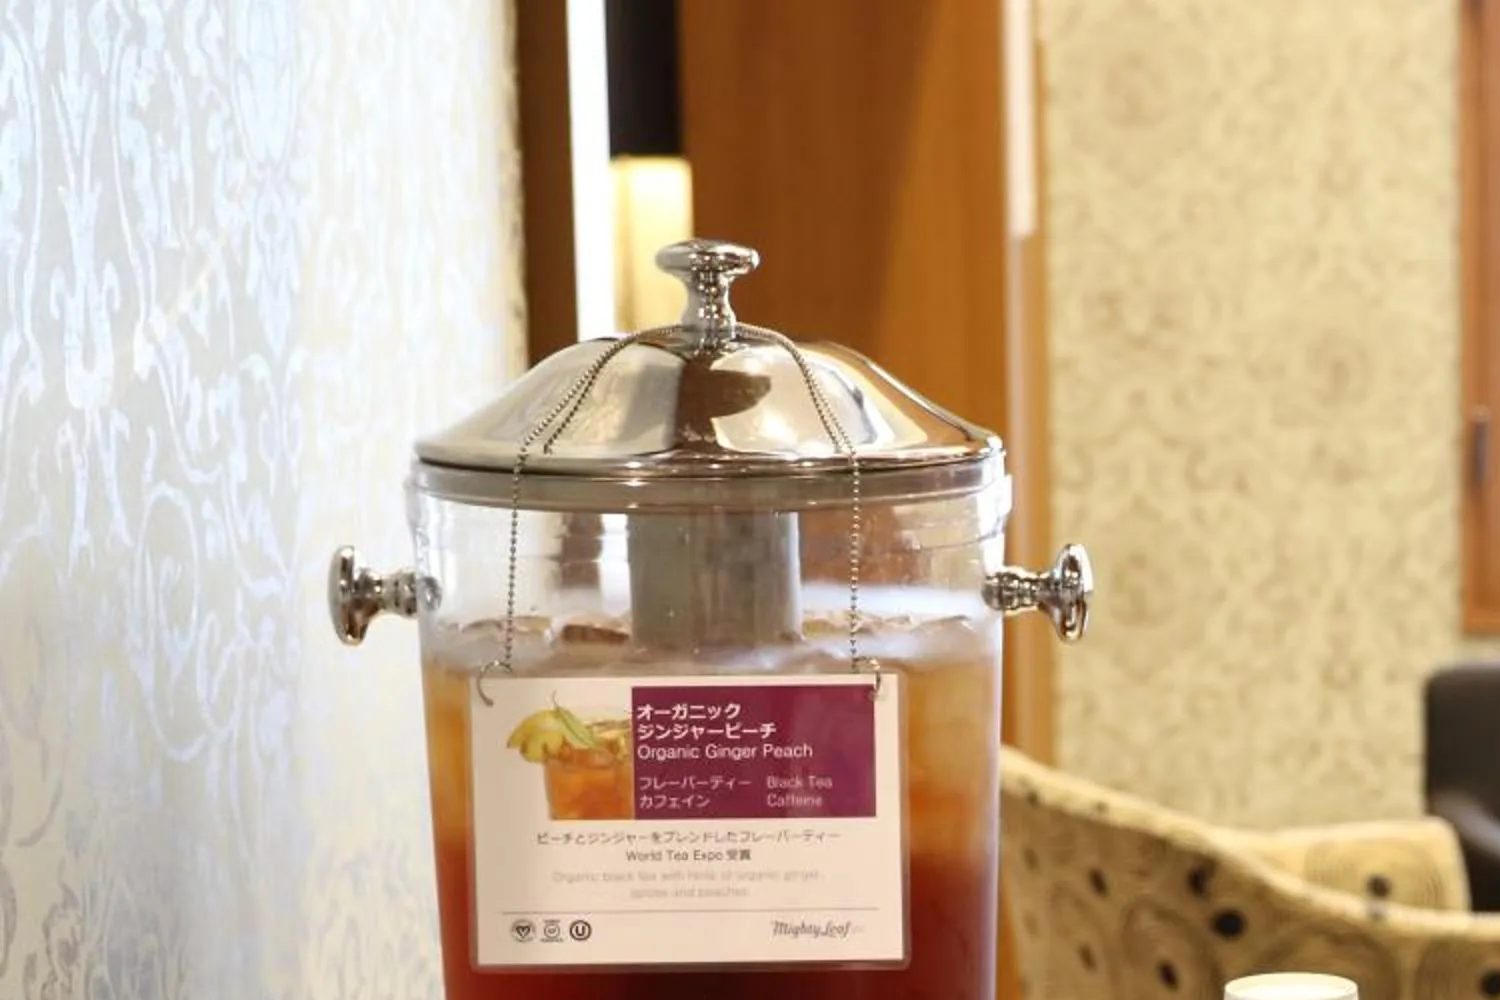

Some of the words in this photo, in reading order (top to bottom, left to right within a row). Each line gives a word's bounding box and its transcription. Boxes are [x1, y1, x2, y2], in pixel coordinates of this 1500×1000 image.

[636, 703, 741, 720] オーガニック
[638, 722, 777, 740] ジンジャーピーチ
[638, 745, 700, 761] Organic
[705, 744, 757, 760] Ginger
[763, 743, 813, 758] Peach
[639, 775, 752, 790] フレーバーティー
[766, 775, 802, 788] Black
[808, 775, 834, 788] Tea
[639, 794, 711, 809] カフェイン
[766, 793, 823, 808] Caffeine
[626, 850, 663, 861] World
[667, 850, 689, 861] Tea
[693, 850, 724, 862] Expo
[772, 920, 821, 938] Mighty
[821, 919, 852, 938] Leaf
